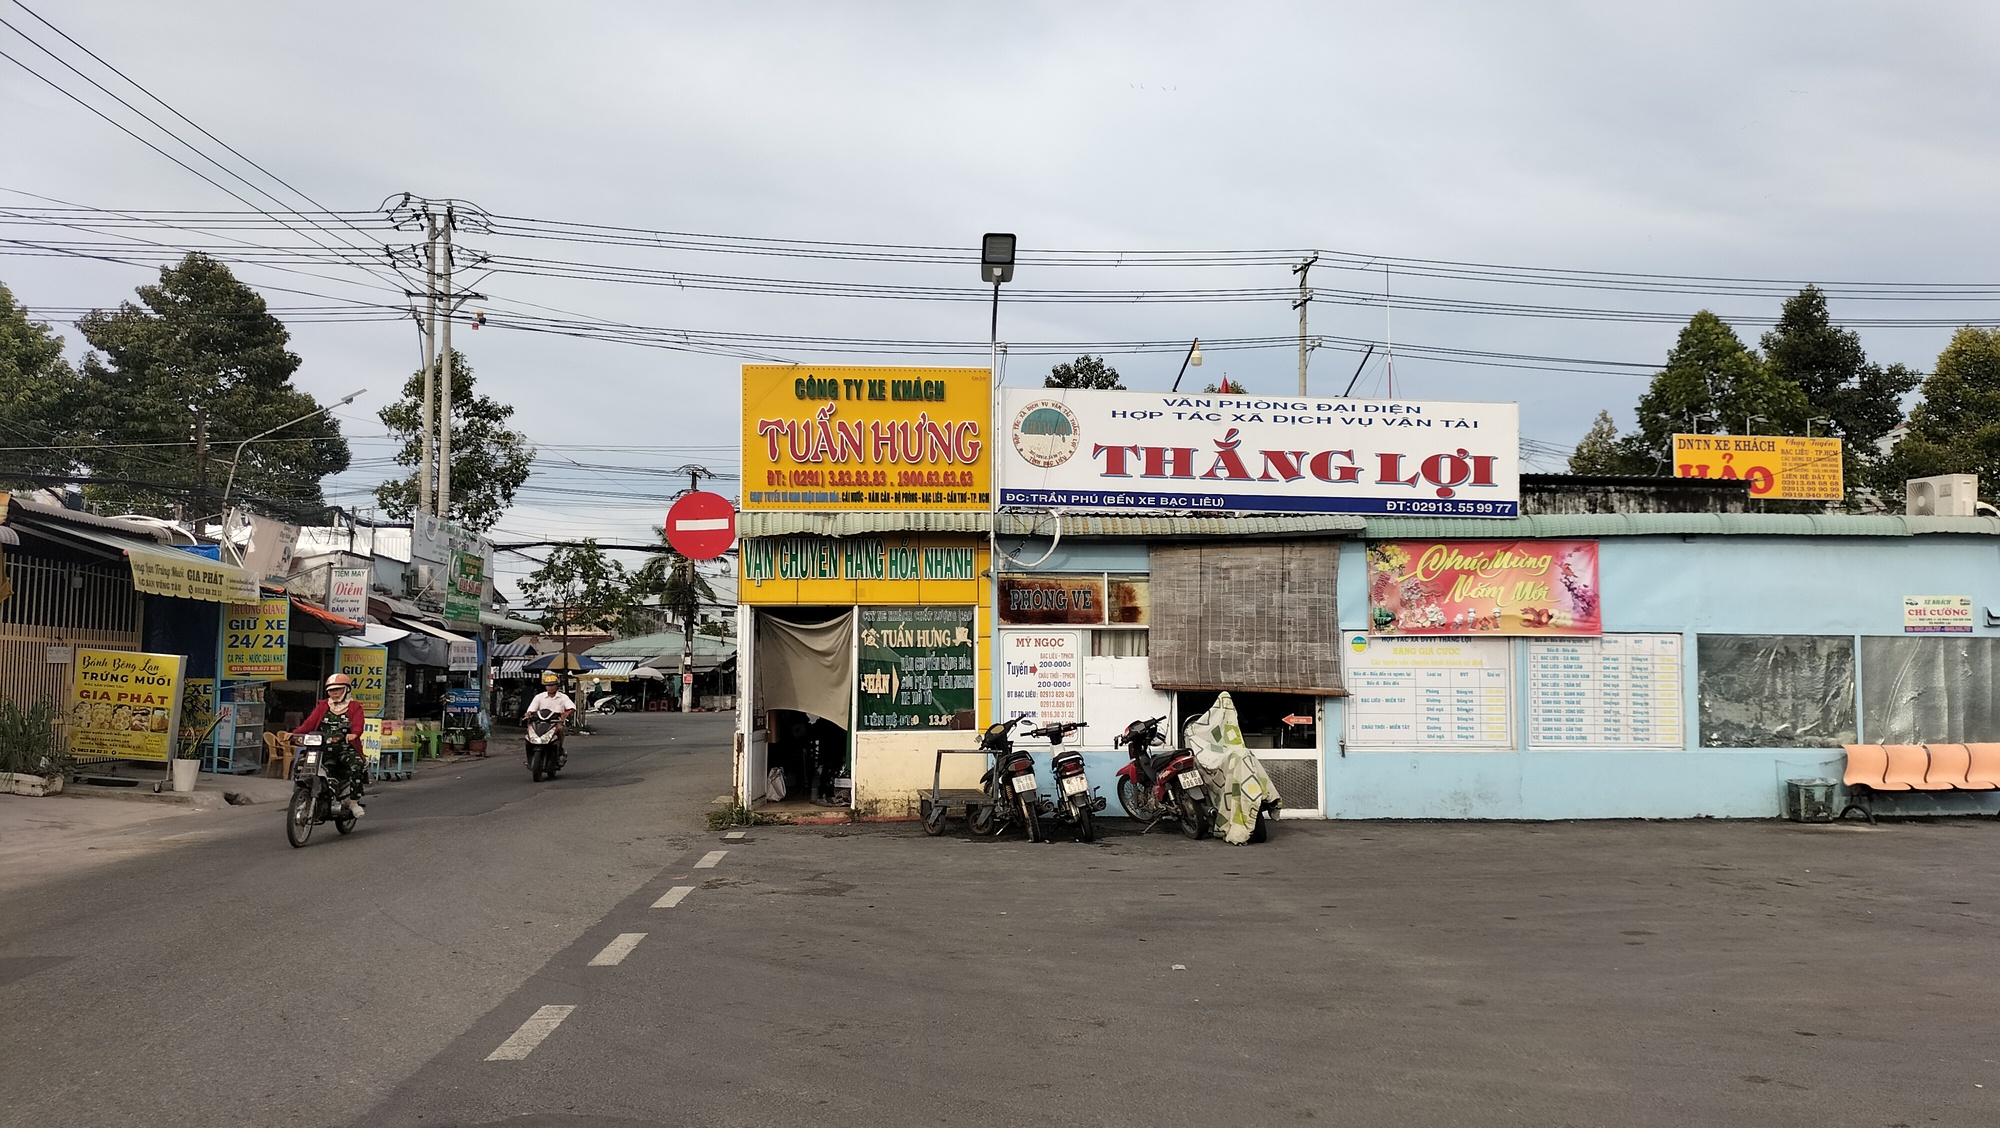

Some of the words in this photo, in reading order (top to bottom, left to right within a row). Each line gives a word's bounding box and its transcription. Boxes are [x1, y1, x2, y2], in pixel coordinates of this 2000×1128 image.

[795, 375, 839, 400] CÔNG
[843, 379, 863, 400] TY
[867, 379, 886, 400] XE
[891, 376, 946, 401] KHÁCH
[1163, 398, 1214, 408] VĂN
[1219, 398, 1308, 411] PHÒNG
[1316, 403, 1355, 413] ĐẠI
[1364, 404, 1421, 415] DIỆN
[1111, 410, 1163, 420] HỢP
[1172, 411, 1221, 421] TÁC
[1232, 412, 1264, 423] XÃ
[1273, 415, 1332, 425] DỊCH
[1341, 417, 1373, 427] VỤ
[1382, 417, 1432, 428] VẬN
[1440, 418, 1478, 429] TẢI
[758, 401, 865, 464] TUẤN
[870, 411, 982, 464] HƯNG
[1678, 438, 1711, 450] DNTN
[1714, 440, 1730, 450] XE
[1734, 438, 1776, 452] KHÁCH
[1092, 428, 1365, 484] THẮNG
[1375, 448, 1499, 499] LỢI
[767, 470, 786, 486] ĐT:
[789, 470, 825, 488] (0291)
[828, 470, 887, 487] 3.83.83.83
[897, 470, 975, 487] 1900.63.63.63
[1006, 491, 1067, 504] ĐC:TRẦN
[1071, 493, 1098, 504] PHÚ
[1102, 493, 1136, 506] (BẾN
[1138, 496, 1156, 505] XE
[1160, 497, 1189, 507] BẠC
[1192, 496, 1225, 507] LIÊU)
[1458, 503, 1474, 512] 55
[1476, 503, 1492, 513] 99
[1495, 504, 1512, 513] 77
[888, 538, 920, 580] HÓA
[924, 547, 974, 580] NHANH
[1486, 549, 1552, 576] Mừng
[187, 569, 201, 582] GIA
[203, 570, 224, 585] PHÁT
[334, 582, 363, 596] Diễm
[1010, 584, 1067, 610] PHÒNG
[1072, 584, 1092, 610] VÉ
[1444, 574, 1515, 607] Năm
[1505, 581, 1561, 602] Mới
[263, 604, 285, 615] GIANG
[1908, 608, 1926, 616] CHÍ
[1930, 608, 1968, 616] CƯỜNG
[229, 617, 259, 630] GIỮ
[265, 619, 286, 630] XE
[881, 621, 914, 647] TUẤN
[916, 627, 951, 648] HƯNG
[1034, 638, 1064, 649] NGỌC
[82, 655, 108, 669] Bánh
[113, 658, 137, 673] Bông
[139, 658, 160, 676] Lan
[342, 664, 364, 675] GIỮ
[368, 666, 383, 675] XE
[1007, 660, 1028, 677] Tuyến
[82, 671, 129, 683] TRỨNG
[135, 675, 171, 686] MUỐI
[351, 678, 382, 689] 4/24
[79, 689, 111, 700] GIA
[192, 684, 213, 694] XE
[1014, 691, 1024, 699] BẠC
